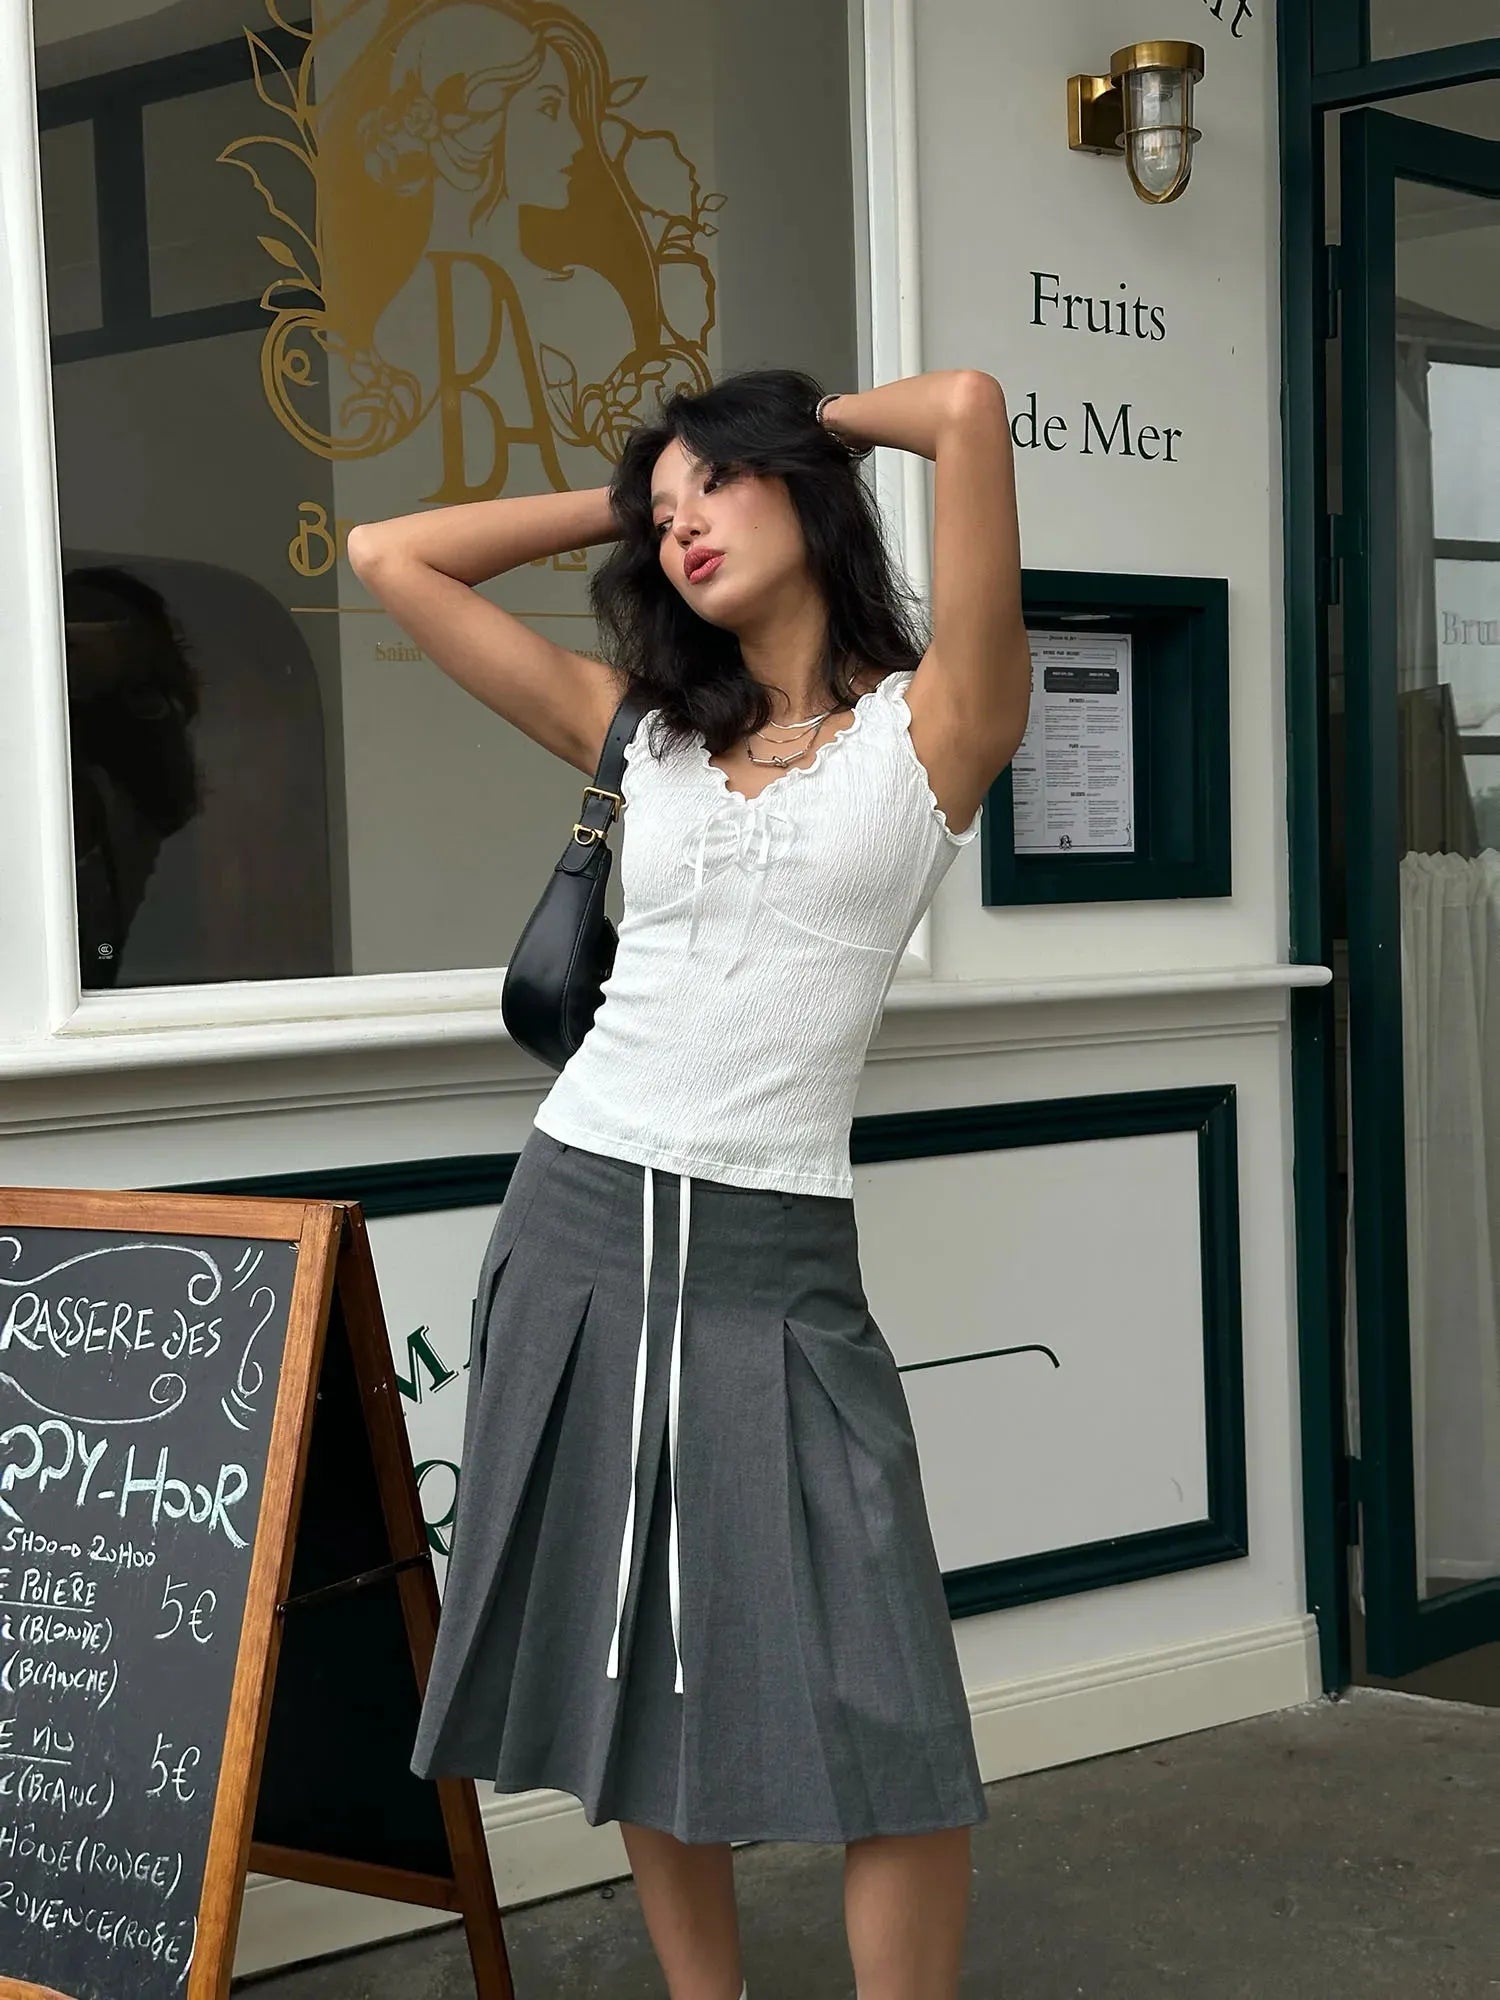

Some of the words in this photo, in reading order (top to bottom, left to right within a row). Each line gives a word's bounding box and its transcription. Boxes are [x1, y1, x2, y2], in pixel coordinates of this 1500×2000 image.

[1029, 270, 1167, 342] Fruits
[1011, 392, 1068, 452] de
[1079, 401, 1183, 463] Mer
[152, 1574, 217, 1644] 5€
[145, 1732, 201, 1801] 5€
